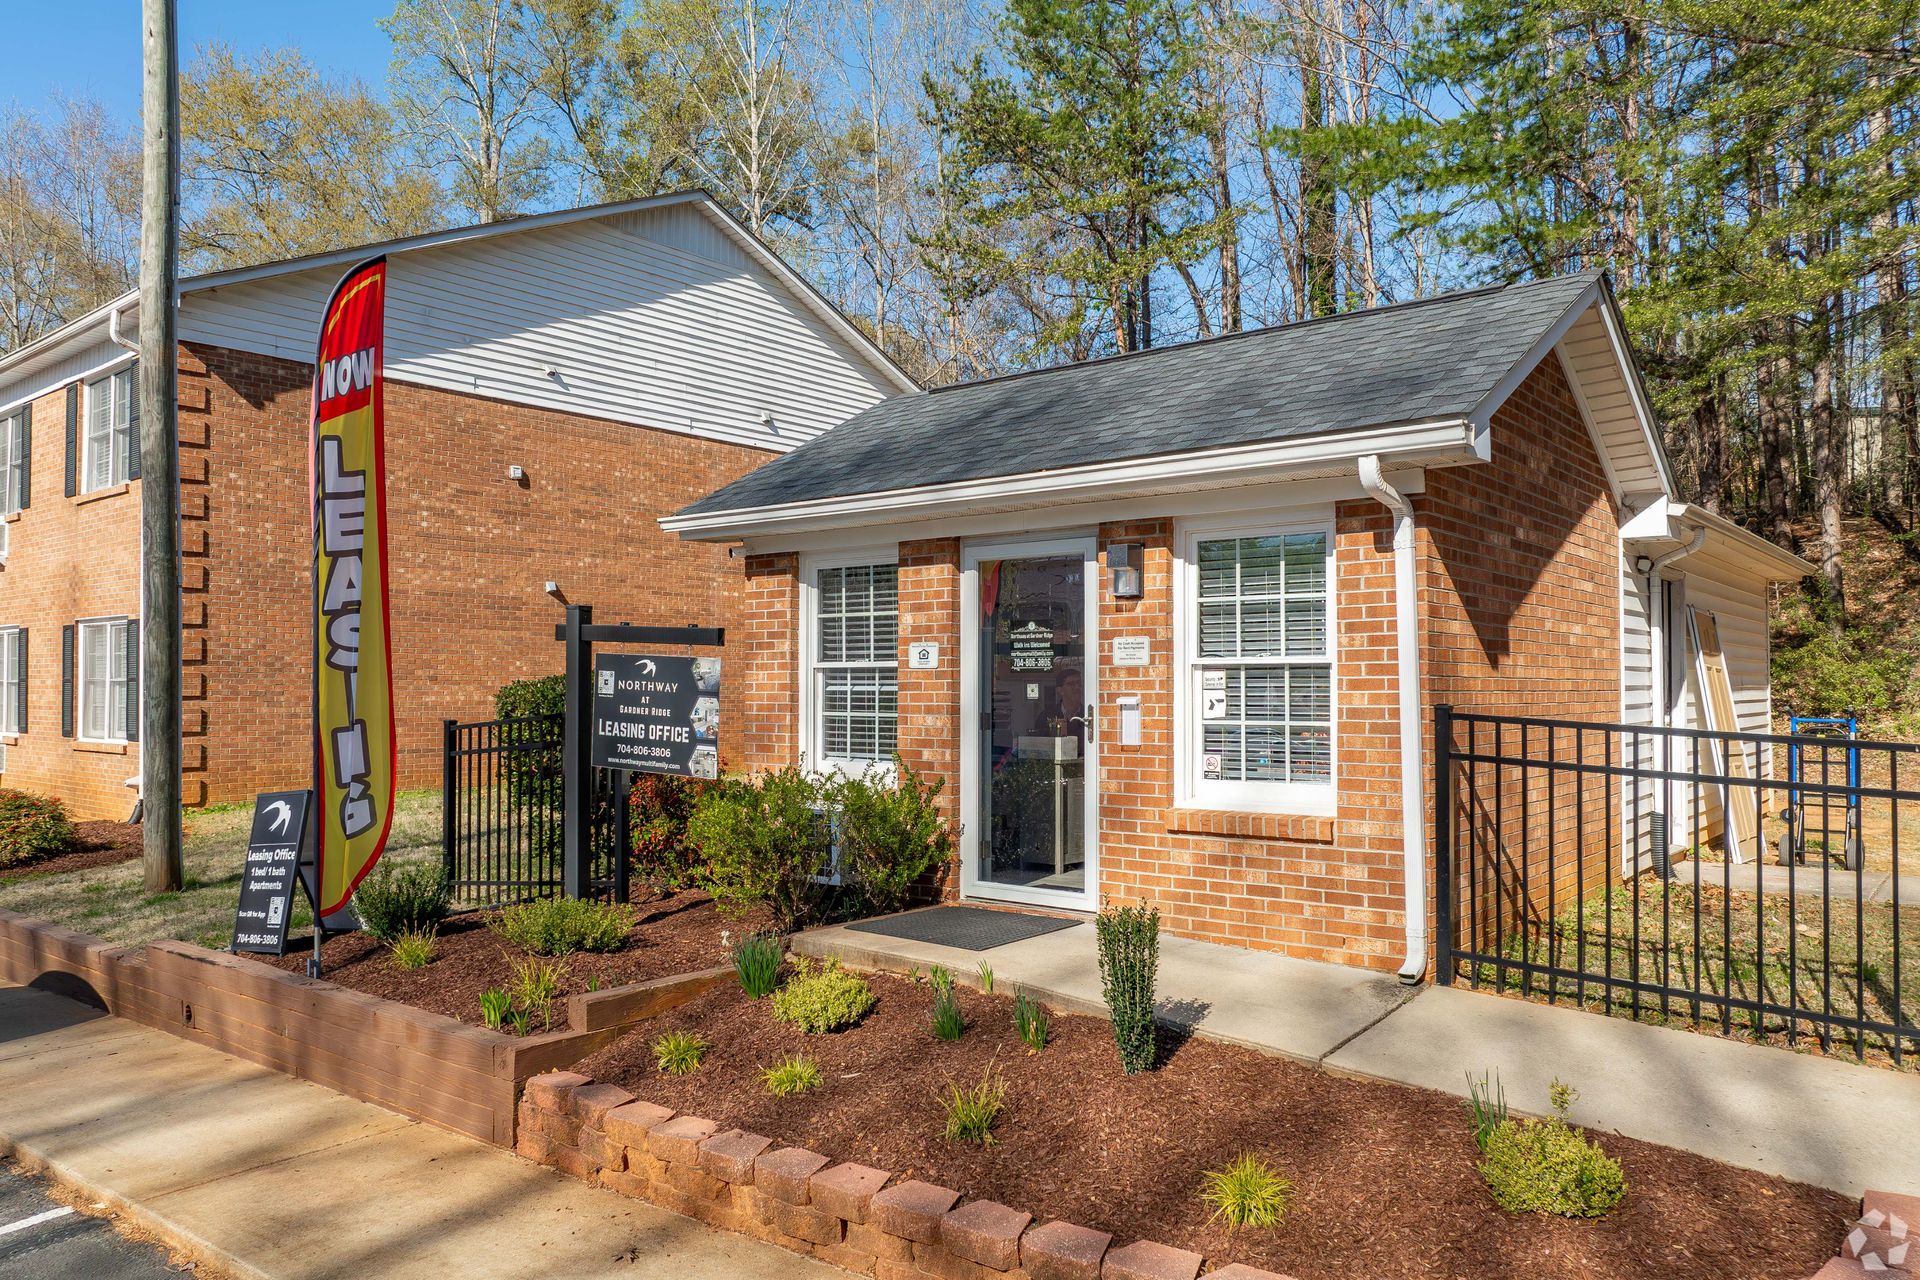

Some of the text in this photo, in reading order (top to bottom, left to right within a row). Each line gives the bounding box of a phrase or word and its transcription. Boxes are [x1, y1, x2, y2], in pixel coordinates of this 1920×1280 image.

[321, 346, 375, 403] NOW
[1014, 658, 1051, 667] 704-806-3806
[618, 680, 678, 693] NORTHWAY
[641, 696, 650, 704] AT
[619, 705, 671, 717] GARDNER RIDGE
[598, 718, 690, 743] LEASING OFFICE
[617, 744, 671, 758] 704-806-3806
[608, 757, 680, 770] www.northwaymultifamily.com
[247, 848, 296, 863] Leasing Office
[272, 866, 286, 876] bath
[249, 880, 282, 892] Apartments
[236, 933, 279, 945] 704-806-3806
